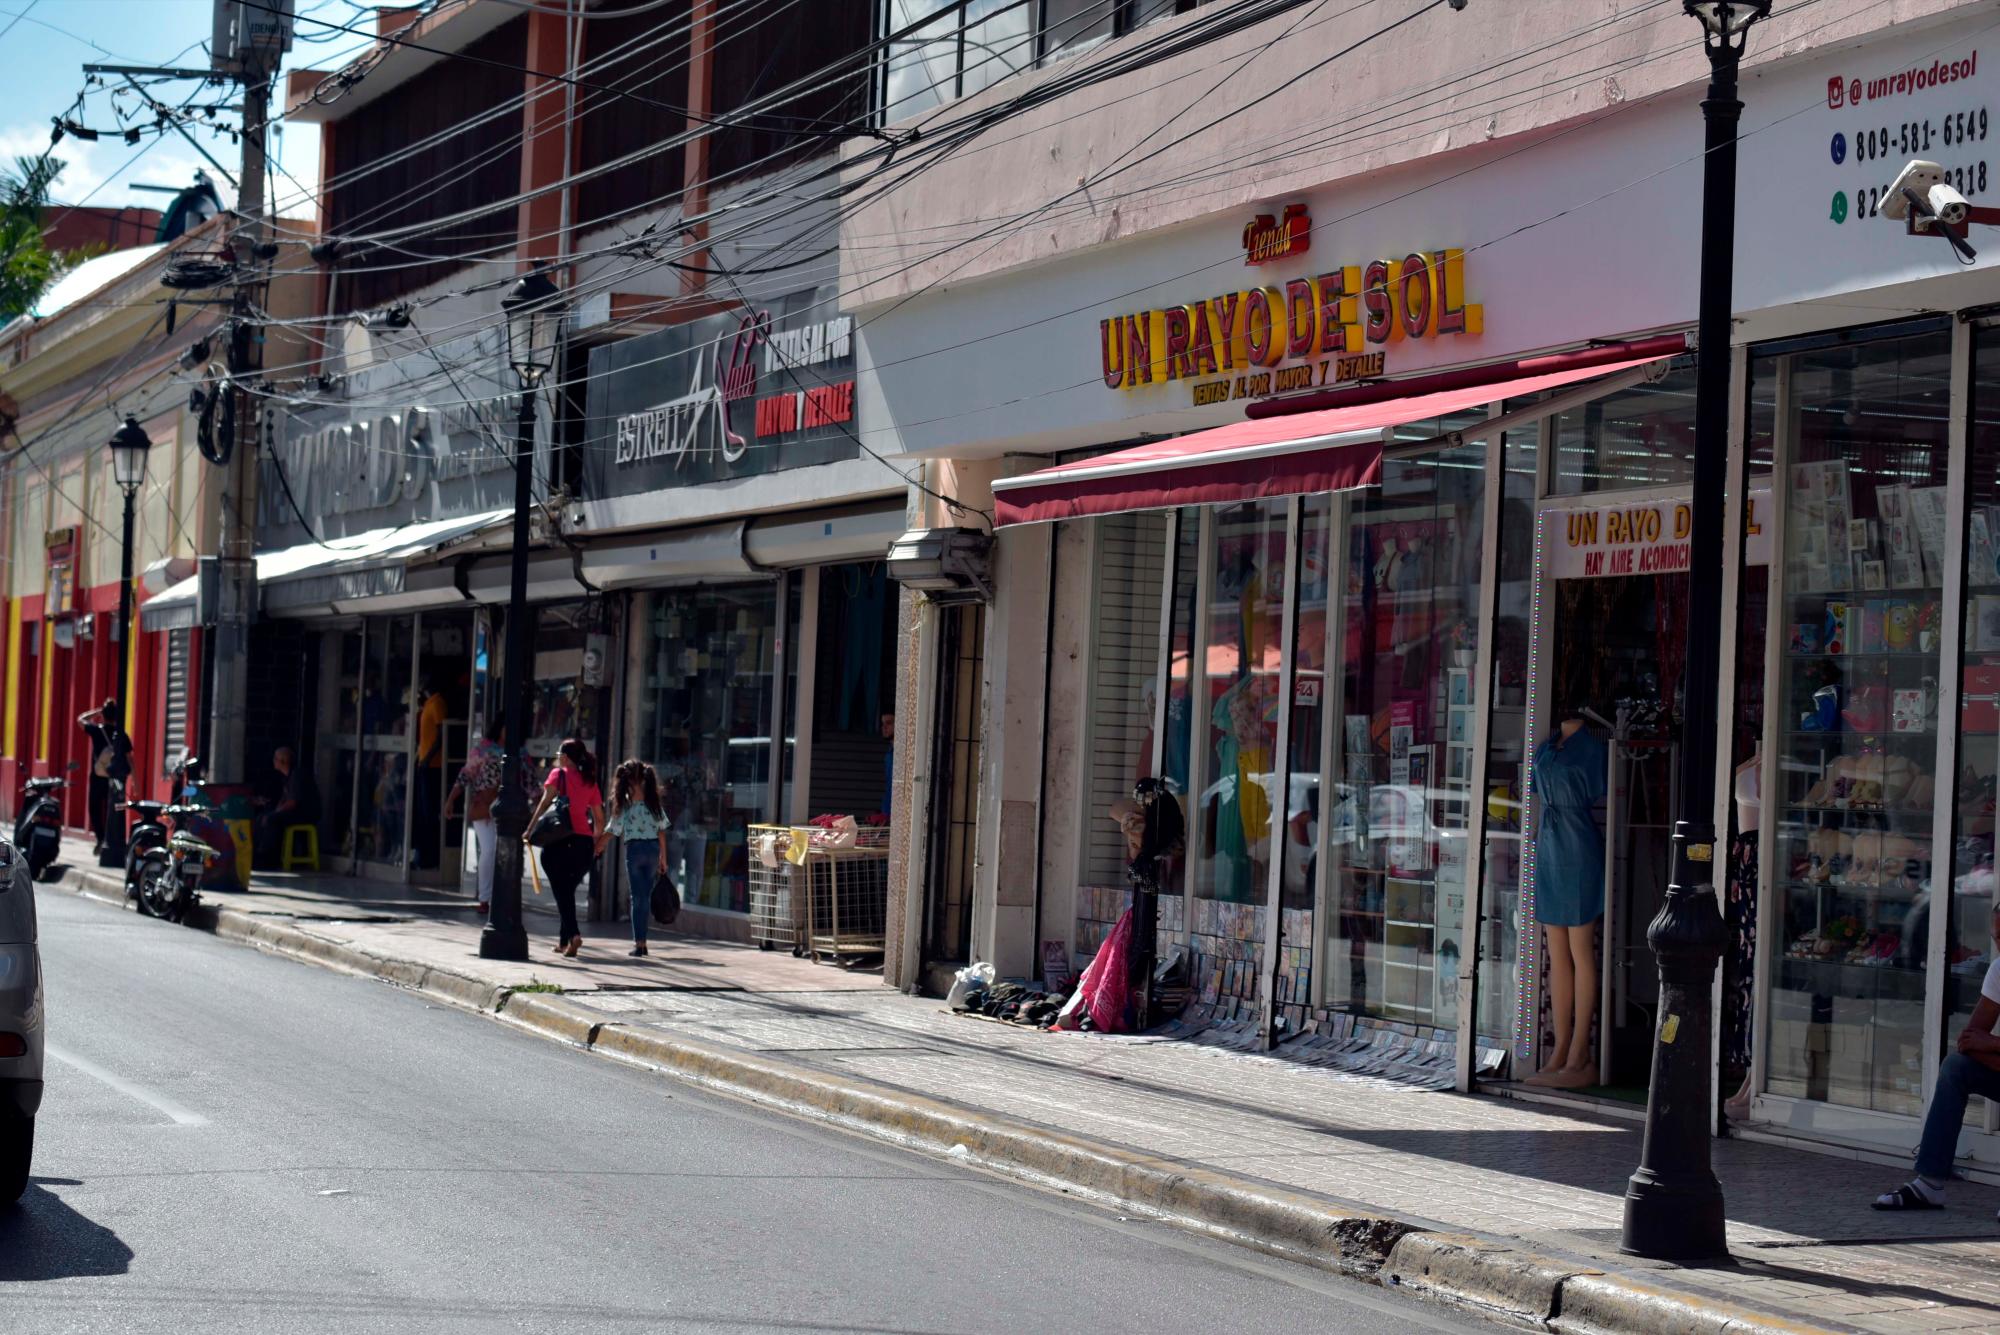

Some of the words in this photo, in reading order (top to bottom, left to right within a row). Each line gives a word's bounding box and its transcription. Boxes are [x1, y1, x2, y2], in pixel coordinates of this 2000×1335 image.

[1867, 50, 1977, 101] unrayodesol
[1243, 205, 1297, 266] Tienda
[765, 325, 811, 373] VENTAS
[825, 316, 852, 361] POR
[1100, 309, 1160, 390] UN
[1164, 285, 1284, 382] RAYO
[1285, 266, 1360, 360] DE
[1364, 248, 1481, 345] SOL
[1193, 380, 1230, 406] VENTAS
[1232, 376, 1247, 400] AL
[1249, 371, 1271, 398] POR
[1275, 364, 1312, 393] MAYOR
[1319, 360, 1329, 385] Y
[1336, 352, 1386, 382] DETALLE
[755, 391, 797, 439] MAYOR
[796, 390, 805, 431] Y
[804, 380, 855, 429] DETALLE
[1567, 511, 1598, 547] UN
[1606, 508, 1661, 545] RAYO
[1585, 551, 1605, 576] HAY
[1609, 548, 1634, 574] AIRE
[1638, 543, 1691, 572] ACONDICI
